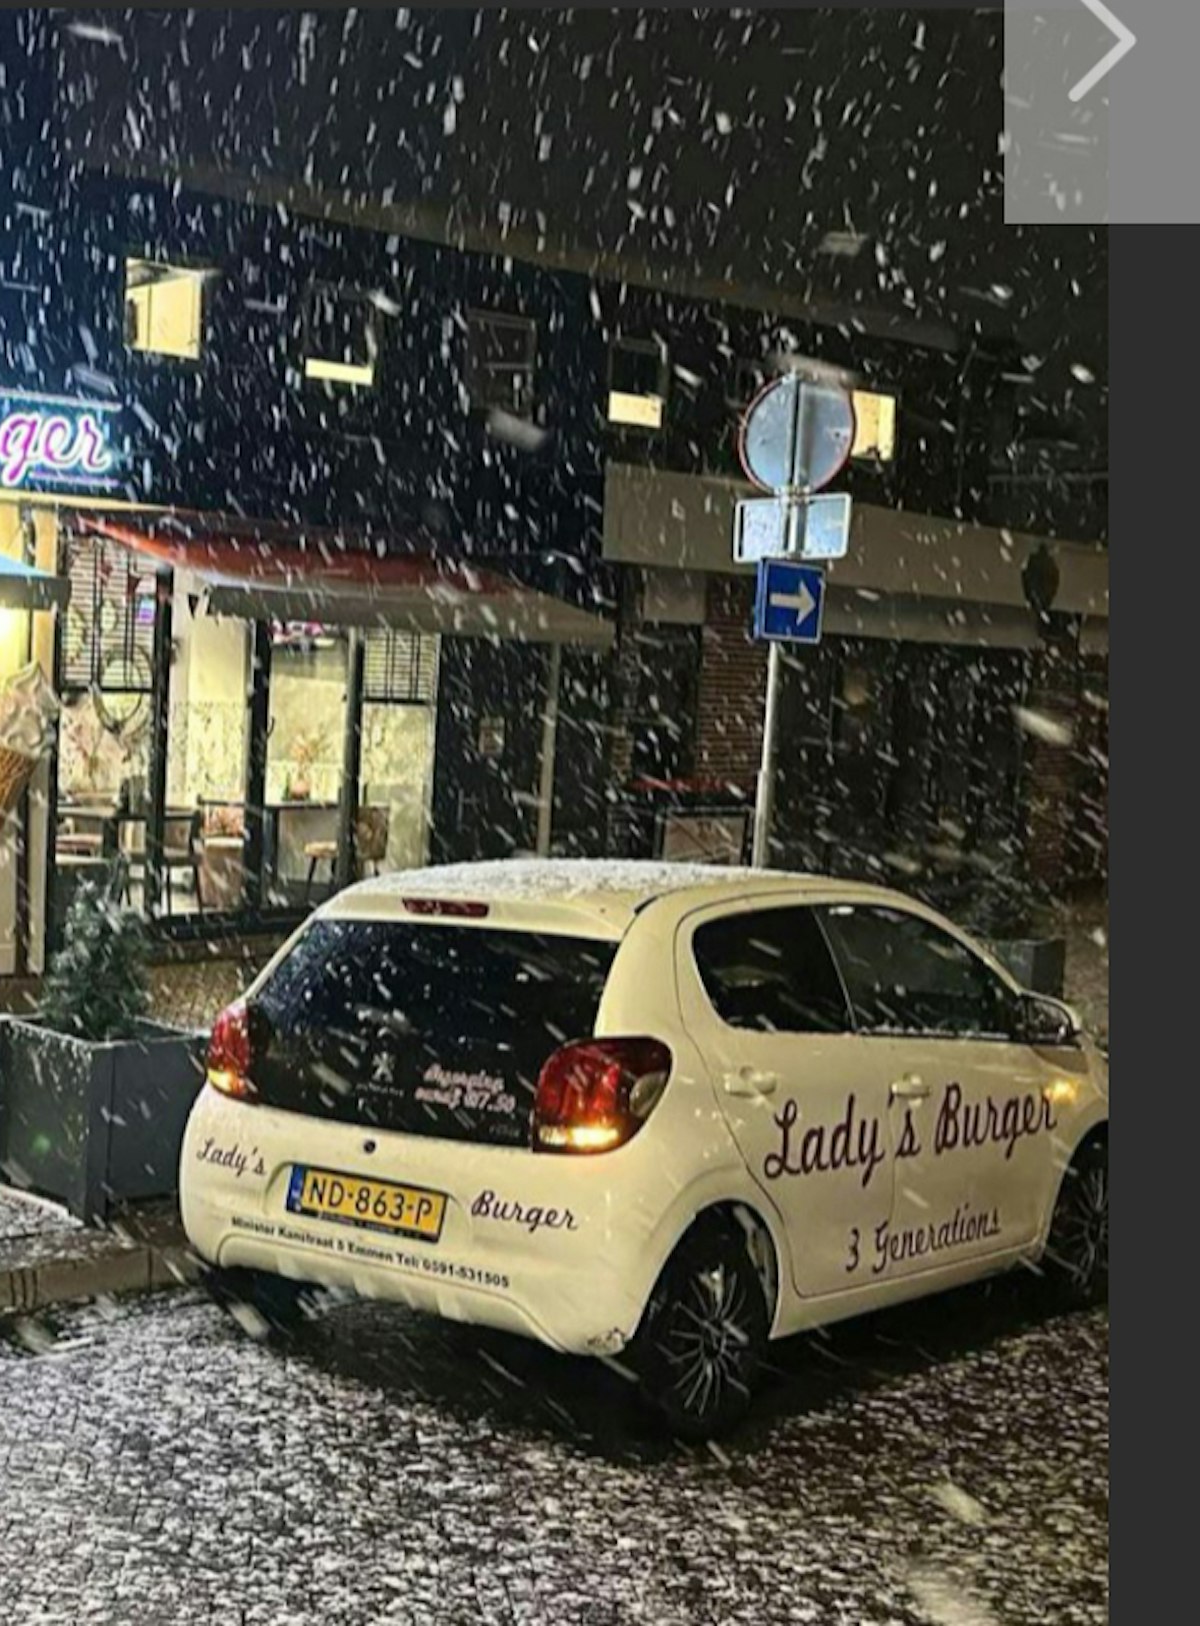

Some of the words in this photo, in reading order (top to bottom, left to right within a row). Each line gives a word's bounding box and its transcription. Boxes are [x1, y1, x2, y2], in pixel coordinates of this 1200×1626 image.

[763, 1090, 922, 1188] Lady's
[934, 1083, 1057, 1160] Burger
[196, 1137, 266, 1178] Lady's
[471, 1189, 578, 1233] Burger
[309, 1177, 432, 1225] ND-863-P
[348, 1241, 393, 1262] Emmen
[845, 1227, 861, 1272] 3
[872, 1203, 1002, 1274] Generations
